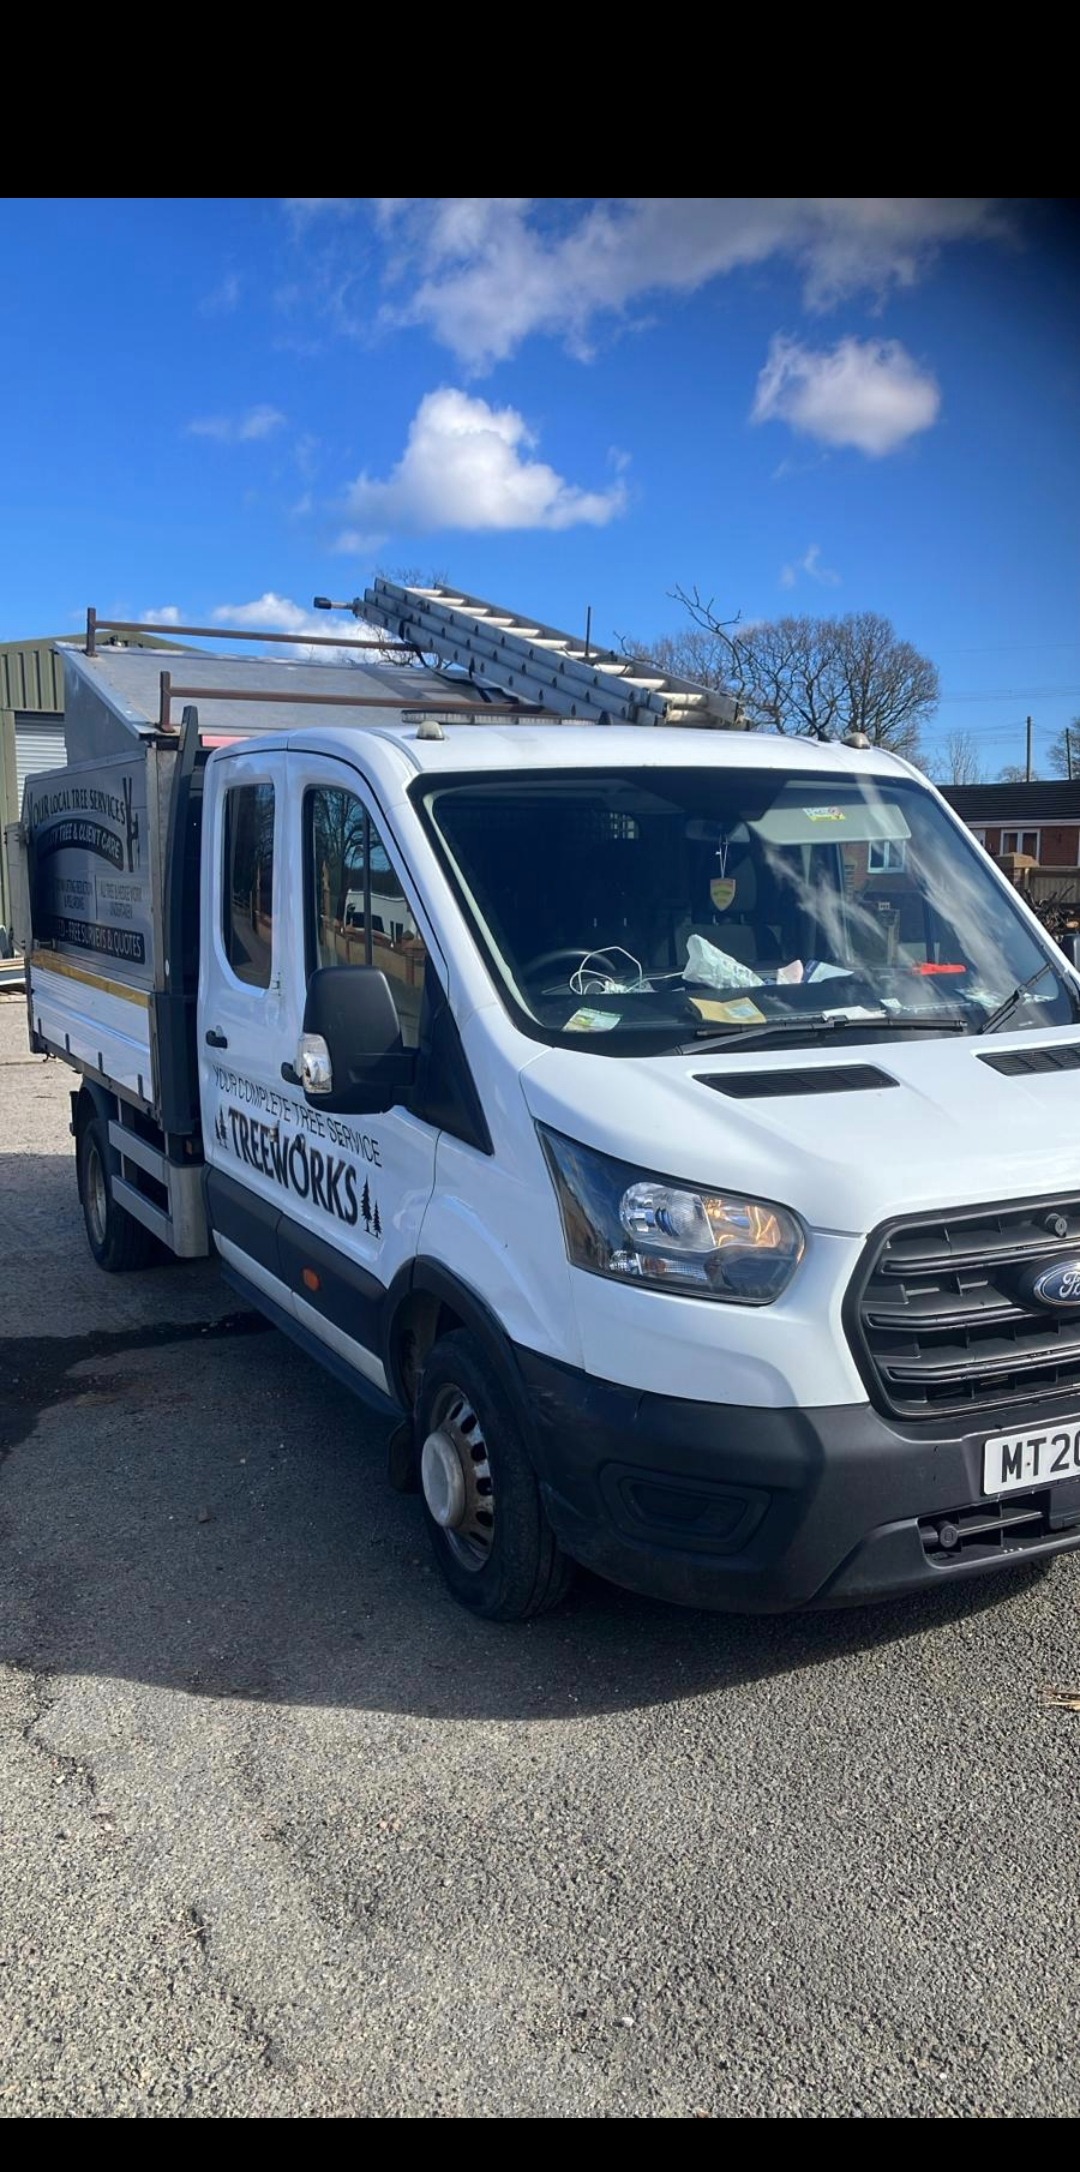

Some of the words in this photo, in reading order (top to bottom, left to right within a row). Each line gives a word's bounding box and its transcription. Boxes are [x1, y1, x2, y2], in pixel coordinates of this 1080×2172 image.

[50, 789, 71, 815] LOCAL
[72, 788, 88, 810] TREE
[89, 788, 126, 825] SERVICES
[101, 831, 121, 860] CARE
[114, 930, 142, 958] QUOTES
[212, 1064, 237, 1095] YOUR
[238, 1077, 291, 1123] COMPLETE
[292, 1102, 326, 1139] TREE
[327, 1116, 383, 1169] SERVICE
[228, 1105, 359, 1227] TREEWORKS
